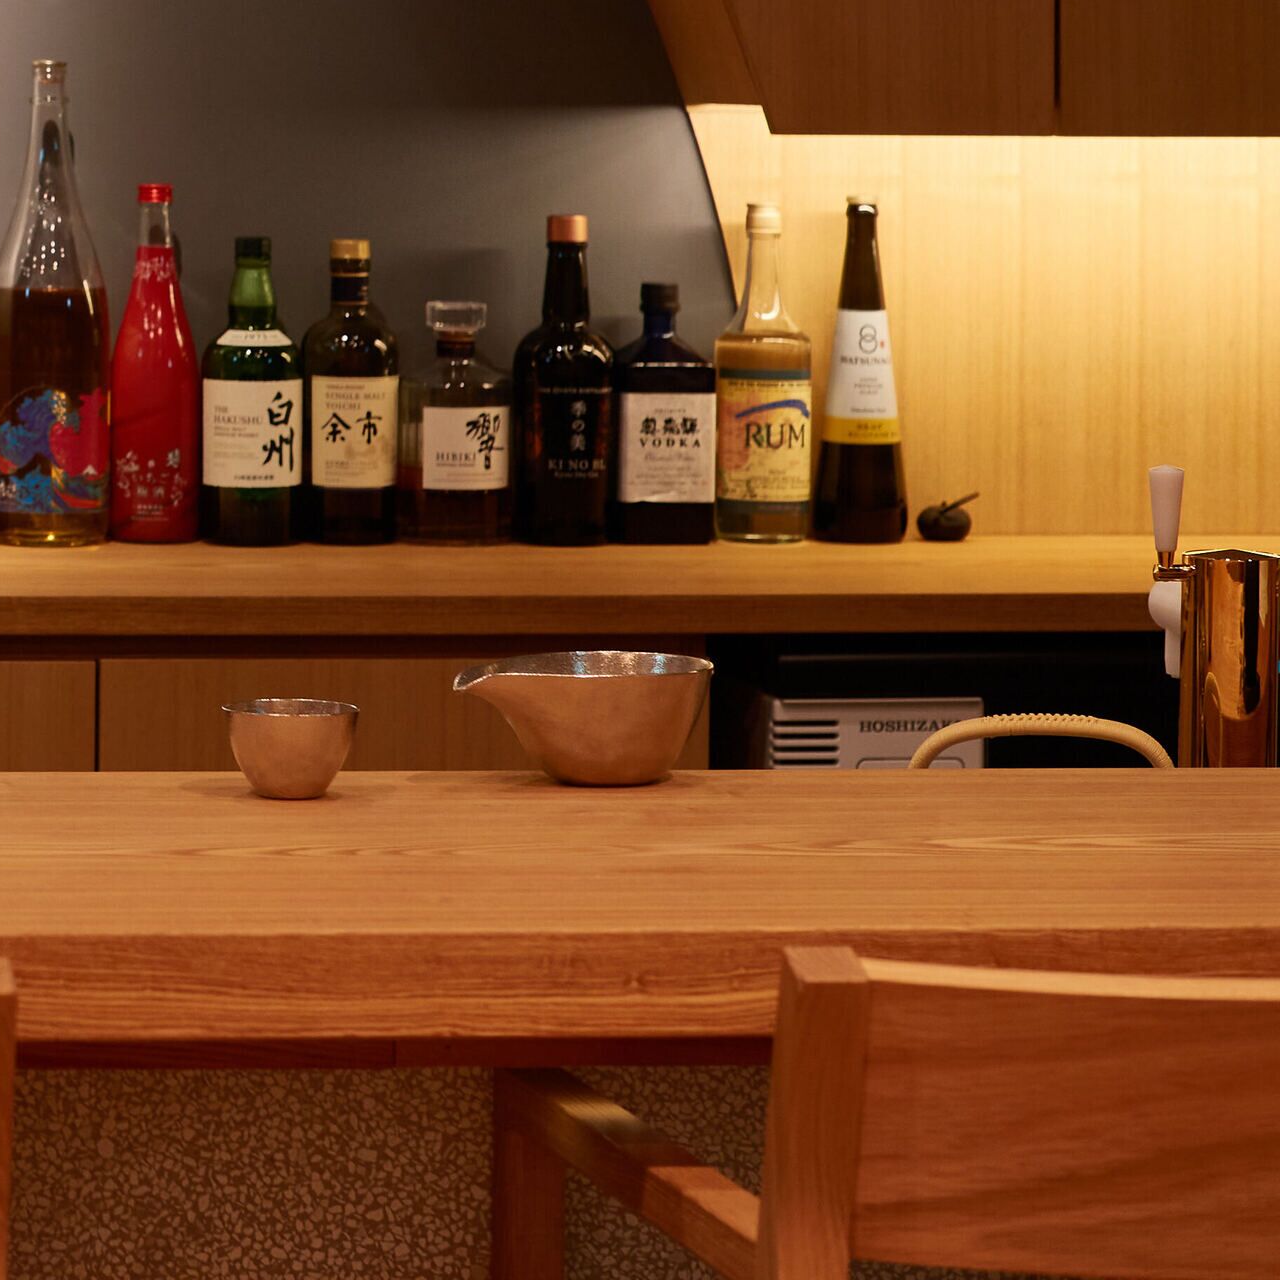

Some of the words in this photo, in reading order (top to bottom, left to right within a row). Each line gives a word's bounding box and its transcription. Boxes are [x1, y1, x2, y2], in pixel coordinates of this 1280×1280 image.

[213, 415, 263, 425] HAKUSHU
[321, 410, 383, 445] 余市
[262, 391, 294, 472] 白州
[744, 421, 805, 449] RUM
[639, 437, 701, 448] VODKA
[436, 451, 476, 462] HIBIKI
